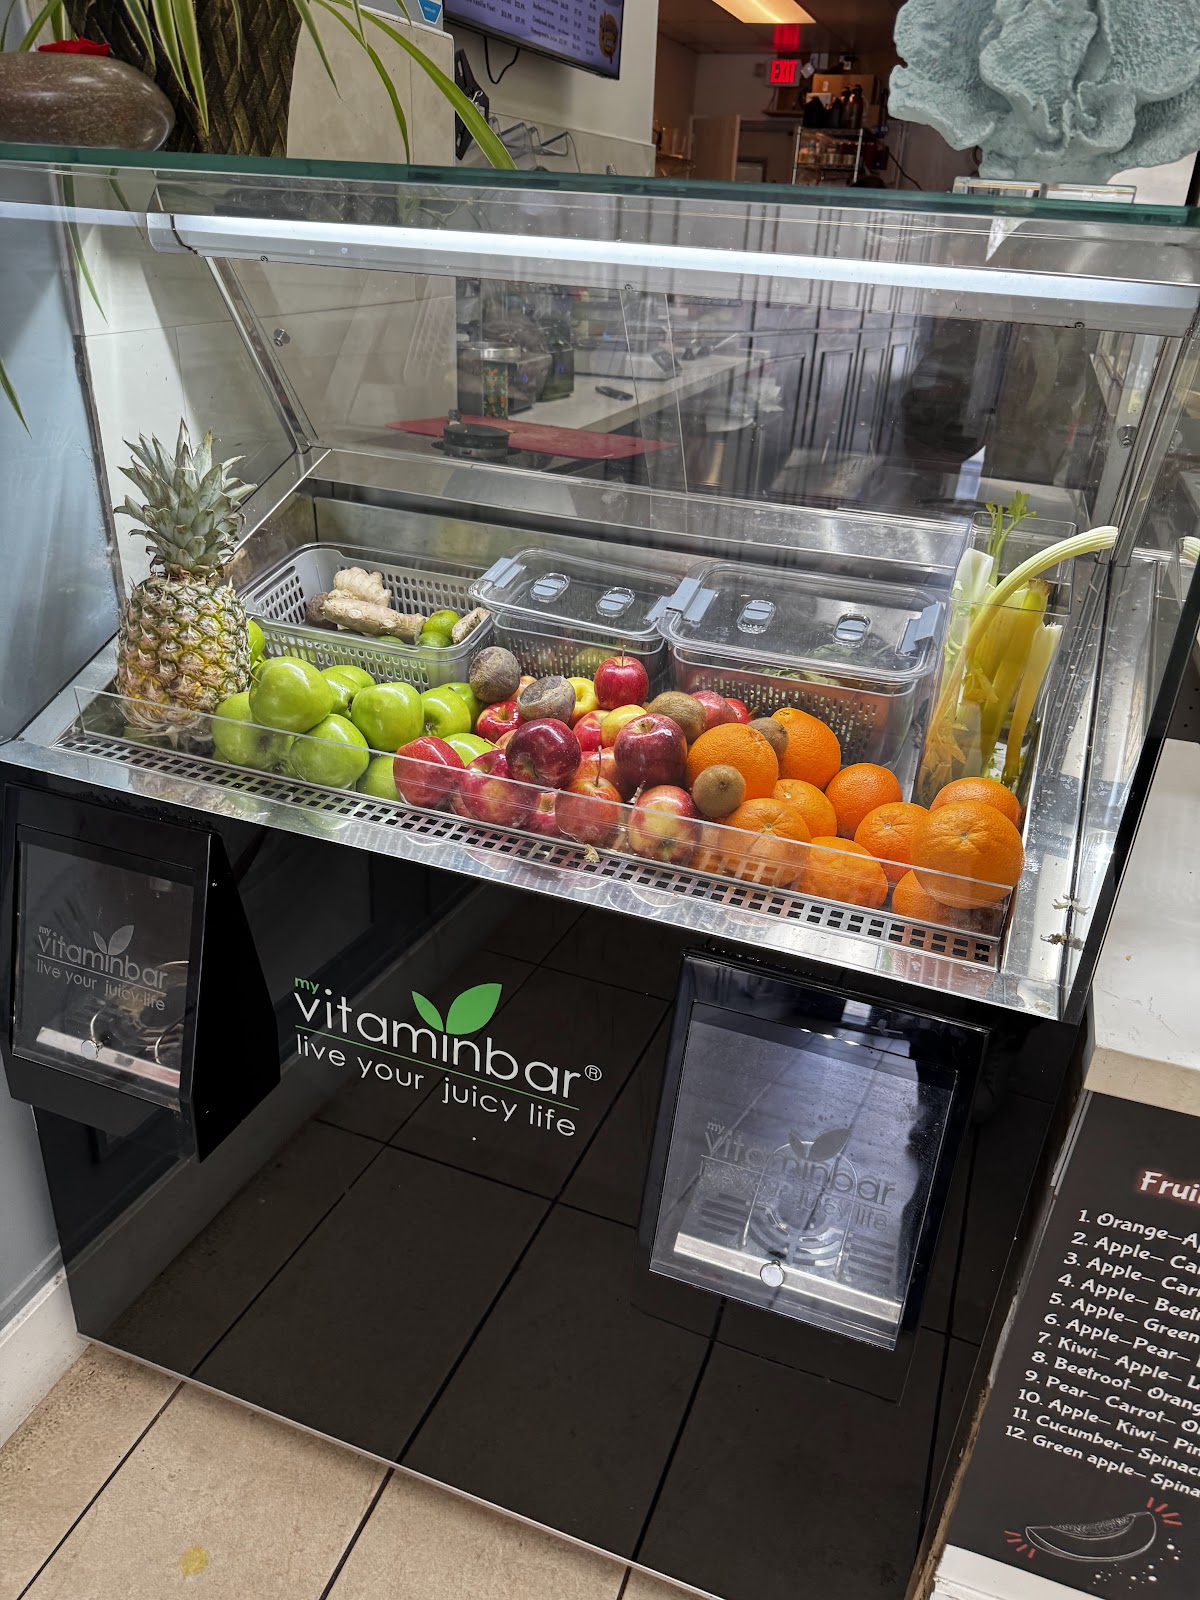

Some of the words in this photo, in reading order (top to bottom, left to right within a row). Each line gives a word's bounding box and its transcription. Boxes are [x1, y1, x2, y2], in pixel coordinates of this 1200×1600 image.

[769, 59, 799, 84] EXIT
[38, 925, 52, 937] my
[37, 931, 168, 989] vitaminbar
[37, 959, 61, 979] live
[65, 971, 98, 990] your
[104, 980, 139, 1003] juicy
[143, 991, 166, 1012] life
[294, 976, 320, 994] my
[296, 1033, 347, 1067] live
[357, 1056, 425, 1091] your
[442, 1077, 518, 1122] juicy
[528, 1103, 577, 1137] life
[704, 1129, 896, 1206] vitaminbar
[1140, 1170, 1200, 1205] Frui
[1078, 1209, 1091, 1223] 1.
[1063, 1252, 1081, 1266] 3.
[1071, 1231, 1088, 1246] 2.
[1169, 1255, 1200, 1275] Ca
[1057, 1273, 1075, 1288] 4.
[1044, 1313, 1060, 1327] 6.
[1049, 1292, 1066, 1306] 5.
[1143, 1318, 1200, 1344] Green
[1037, 1331, 1052, 1346] 7.
[1031, 1350, 1049, 1365] 8.
[1025, 1370, 1040, 1384] 9.
[1018, 1388, 1043, 1406] 10.
[1012, 1406, 1031, 1422] 11.
[1005, 1425, 1028, 1441] 12.
[1032, 1434, 1083, 1460] Green
